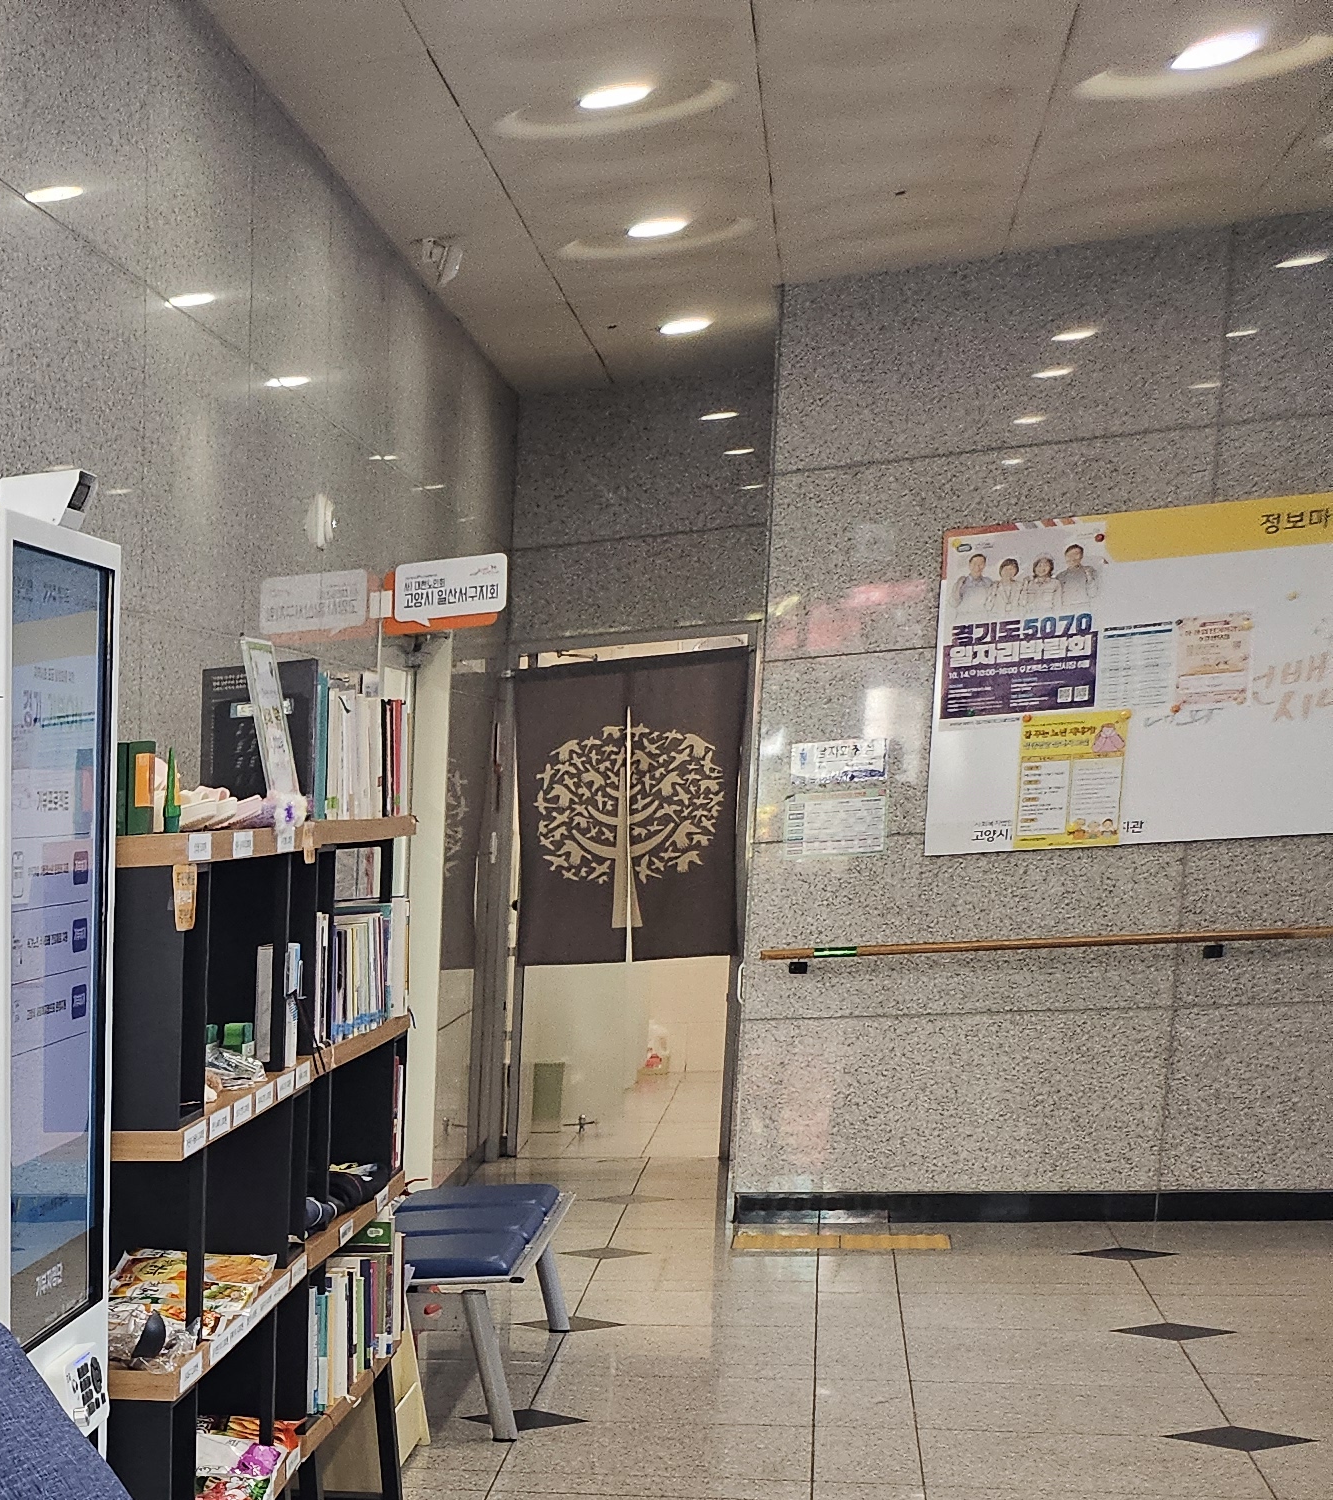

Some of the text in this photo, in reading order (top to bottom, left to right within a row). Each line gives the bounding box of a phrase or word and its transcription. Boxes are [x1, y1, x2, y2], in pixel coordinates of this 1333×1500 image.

[404, 583, 499, 608] 고양시 일산서구지회
[949, 634, 1092, 668] 일자리박람회
